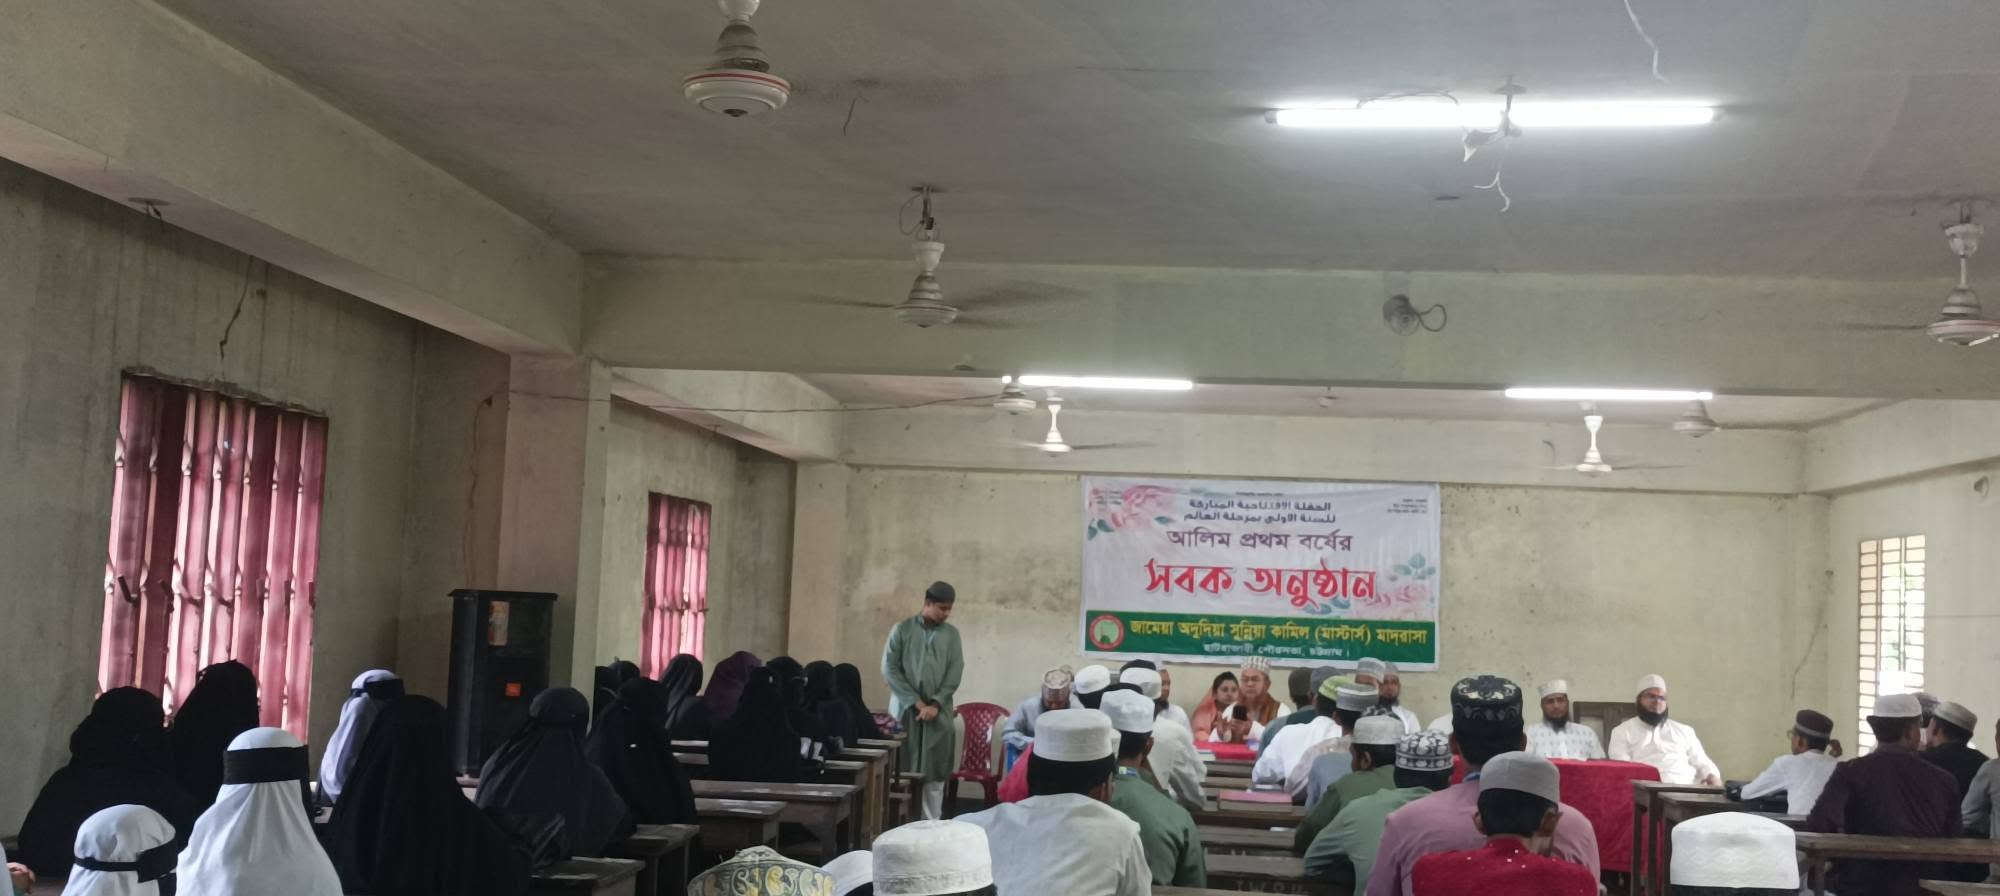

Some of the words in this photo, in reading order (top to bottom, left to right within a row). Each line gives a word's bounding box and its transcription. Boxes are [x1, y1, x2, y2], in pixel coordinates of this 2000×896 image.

[1166, 527, 1232, 548] আলিম
[1240, 532, 1291, 550] প্রথম
[1298, 529, 1353, 552] বর্ষের
[1144, 558, 1234, 595] সবক
[1243, 557, 1376, 610] অনুষ্ঠান
[1129, 619, 1175, 637] জামেয়া
[1178, 618, 1225, 639] অদুদিয়া
[1229, 619, 1267, 641] সুন্নিয়া
[1271, 621, 1310, 640] কামিল
[1315, 624, 1371, 646] (মাস্টার্স)
